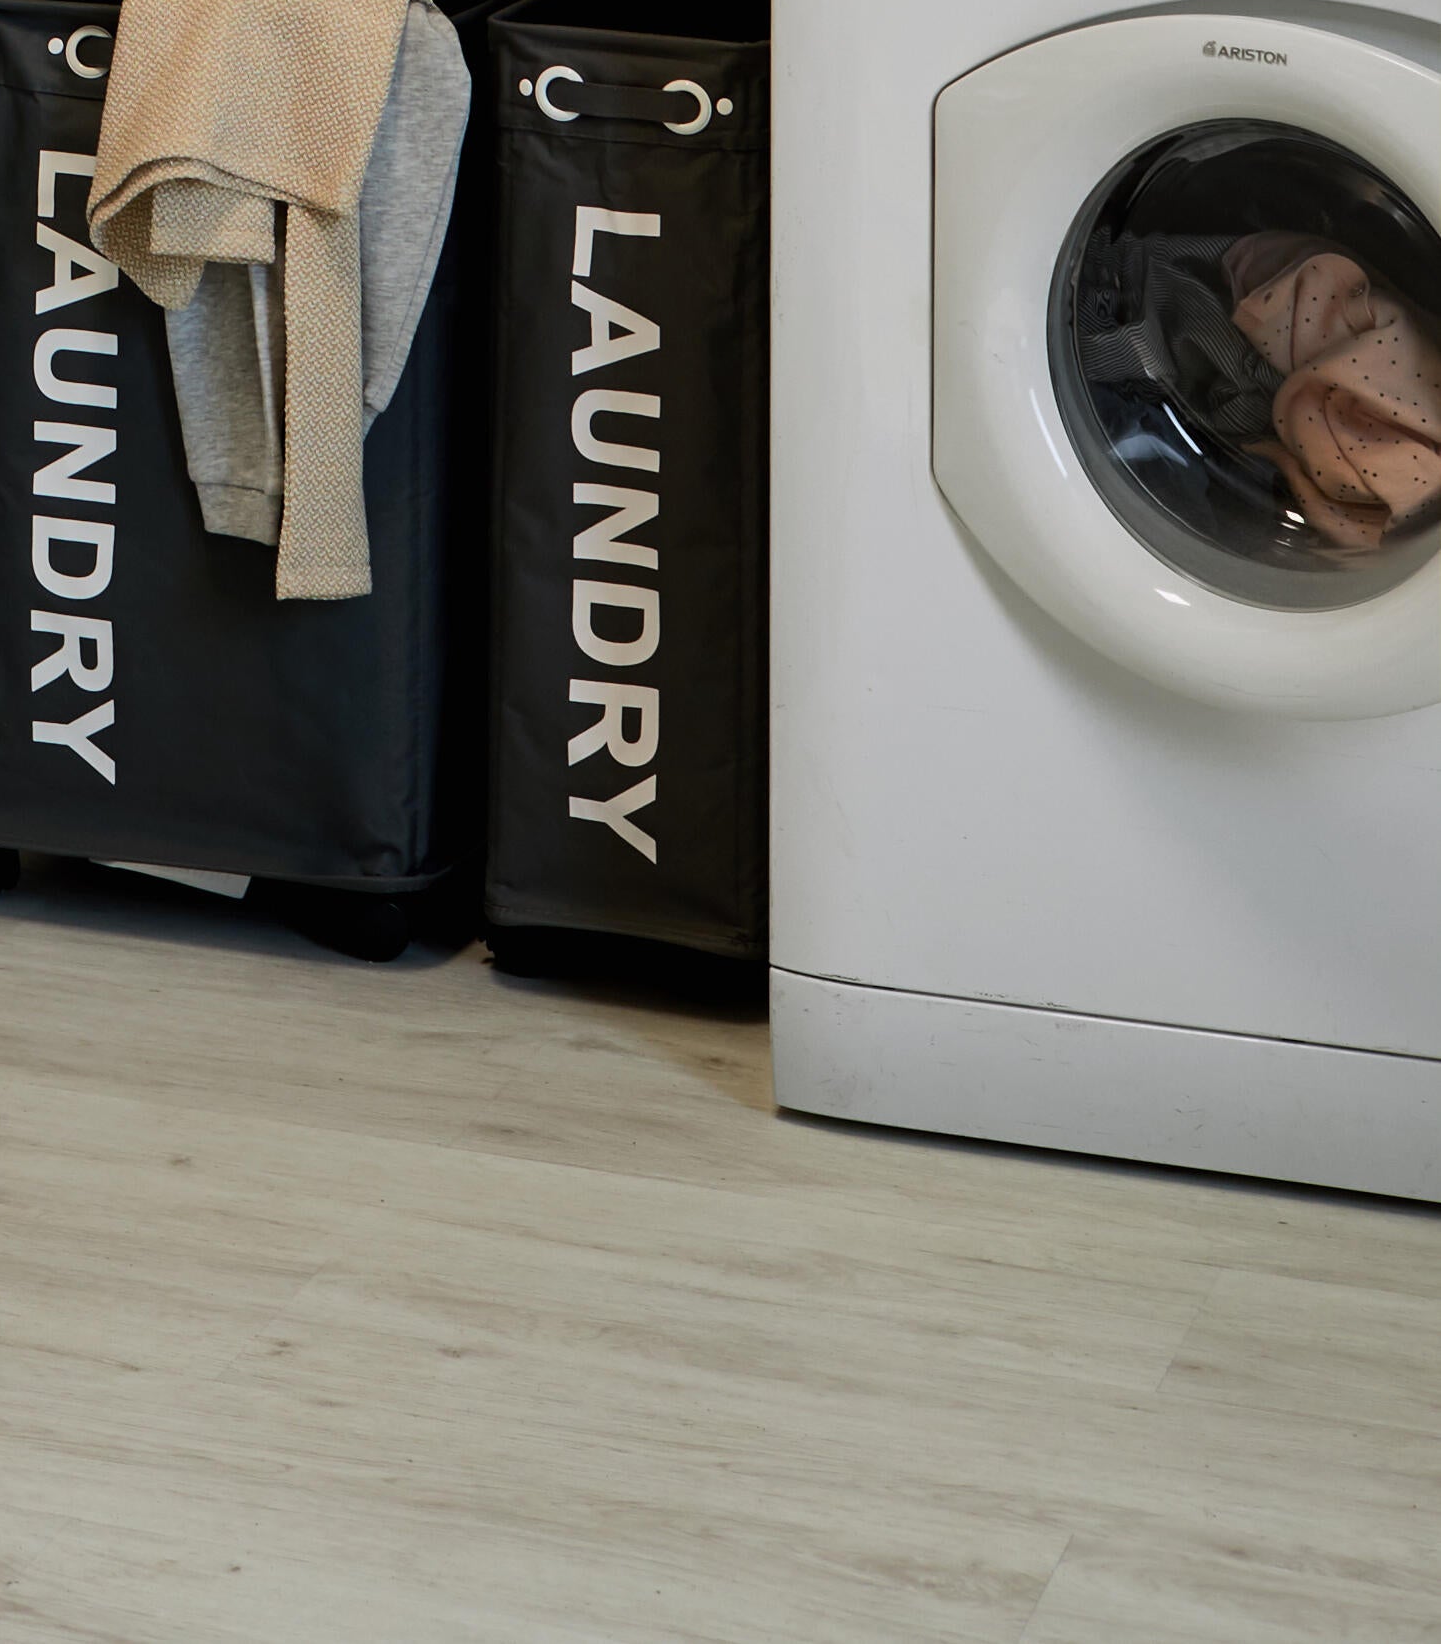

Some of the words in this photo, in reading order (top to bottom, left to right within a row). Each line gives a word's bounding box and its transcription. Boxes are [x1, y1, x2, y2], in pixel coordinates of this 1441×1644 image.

[1217, 45, 1289, 67] ARISTON
[31, 148, 119, 787] LAUNDRY
[567, 205, 662, 865] LAUNDRY
